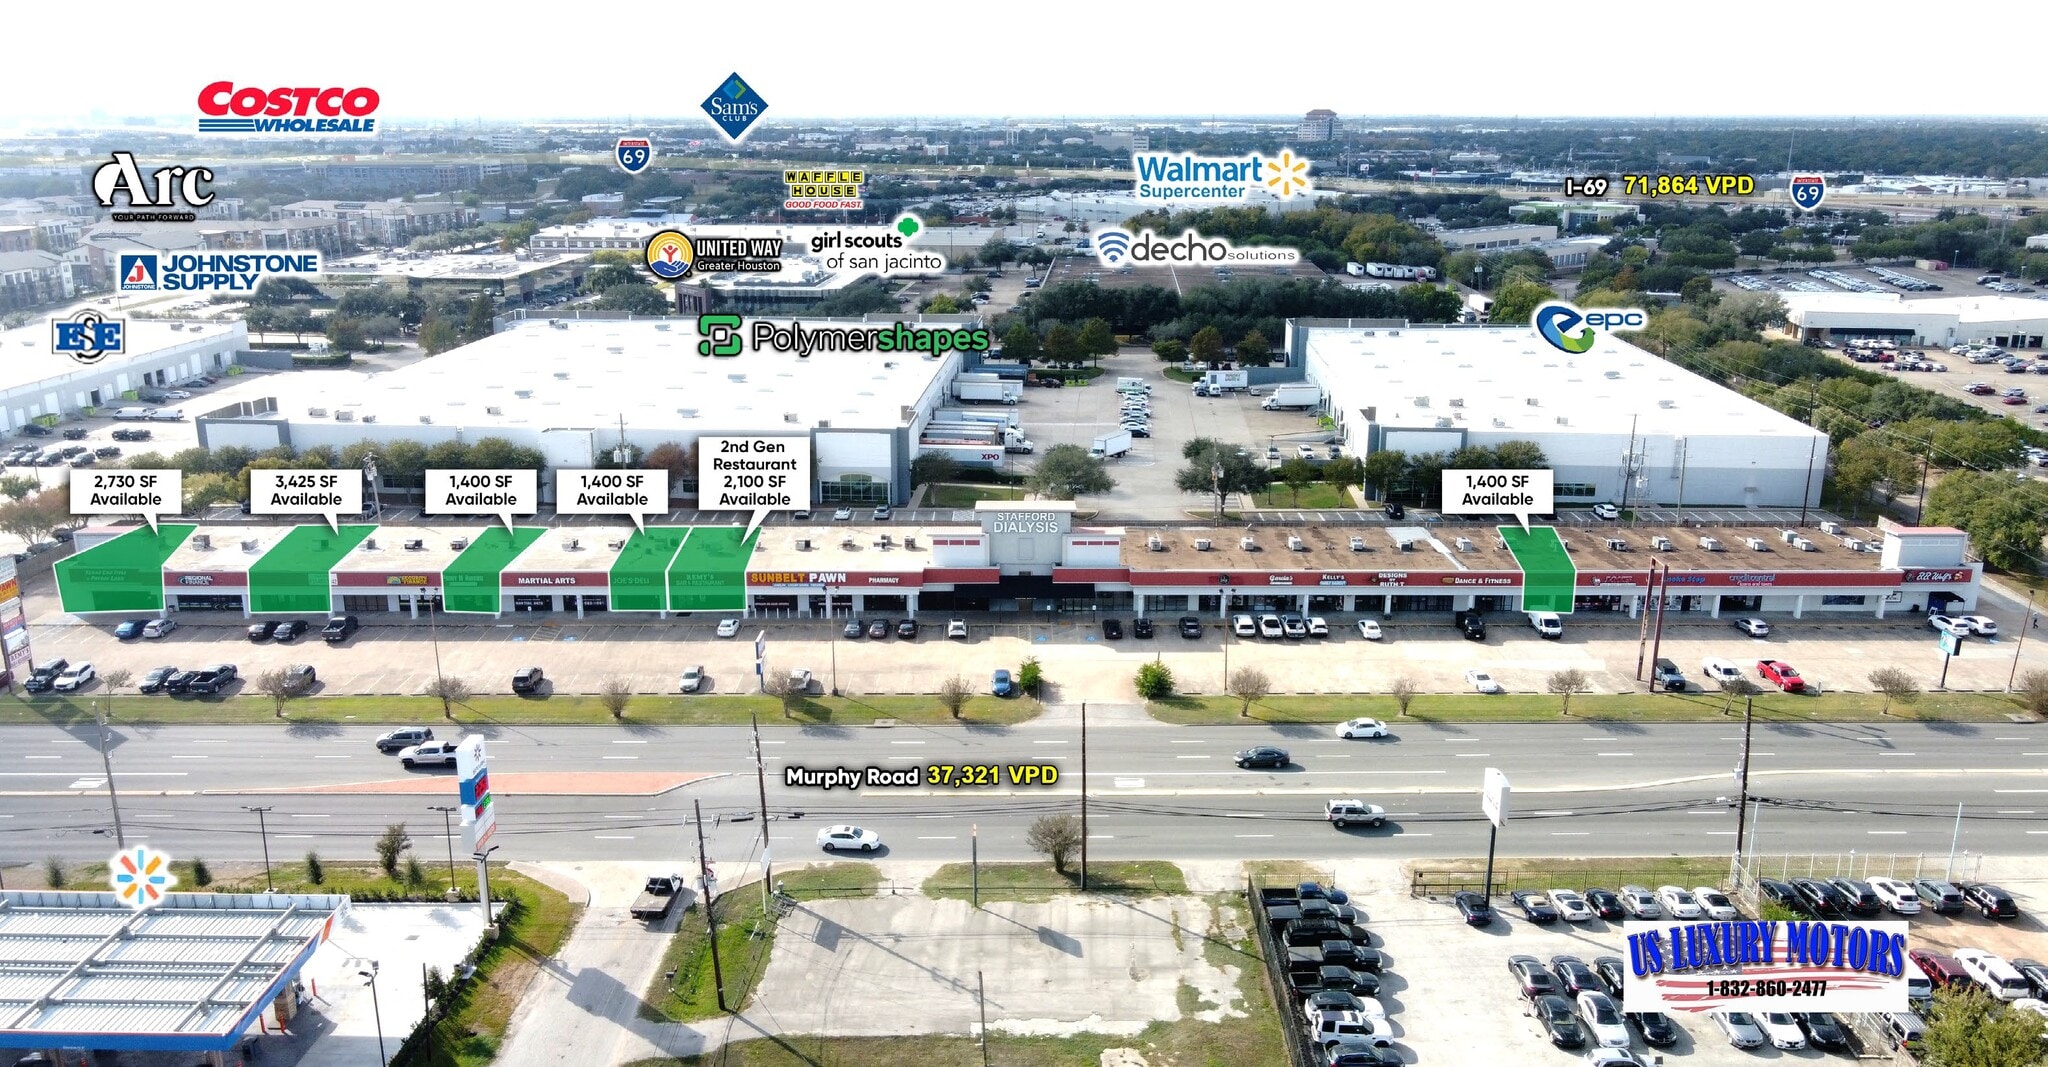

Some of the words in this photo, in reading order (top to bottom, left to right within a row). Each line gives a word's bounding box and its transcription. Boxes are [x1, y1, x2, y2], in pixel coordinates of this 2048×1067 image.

[997, 512, 1055, 521] STAFFORD
[993, 522, 1058, 533] DIALYSIS
[751, 573, 805, 582] SUNBELT
[809, 573, 846, 582] PAWN
